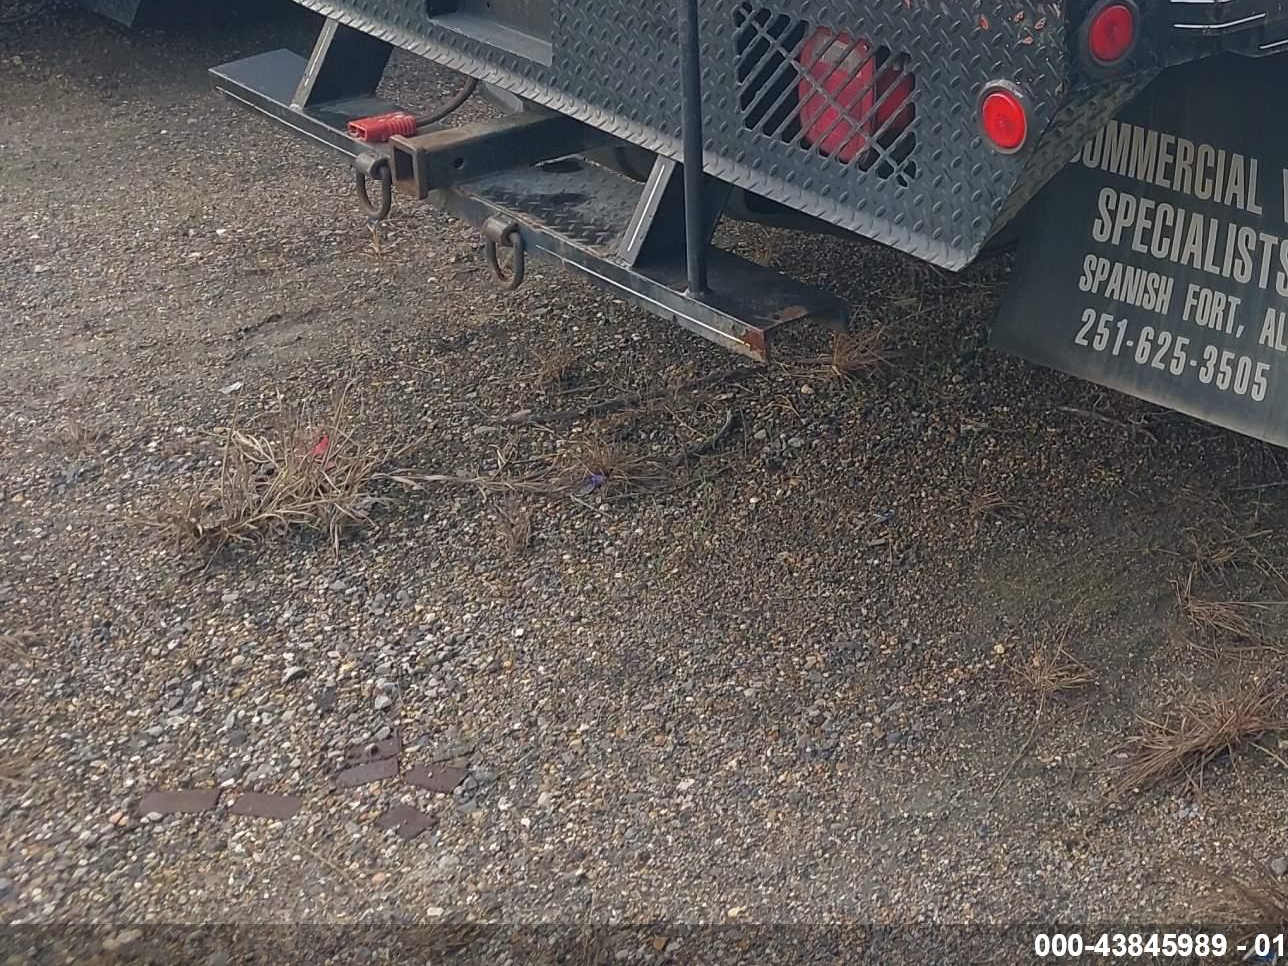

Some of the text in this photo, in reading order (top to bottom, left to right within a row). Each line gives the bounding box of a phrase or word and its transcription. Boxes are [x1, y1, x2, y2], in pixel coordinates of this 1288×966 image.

[1069, 120, 1263, 215] OMMERCIAL
[1079, 254, 1288, 352] SPANISH FORT, AL
[1073, 308, 1272, 402] 251-625-3505
